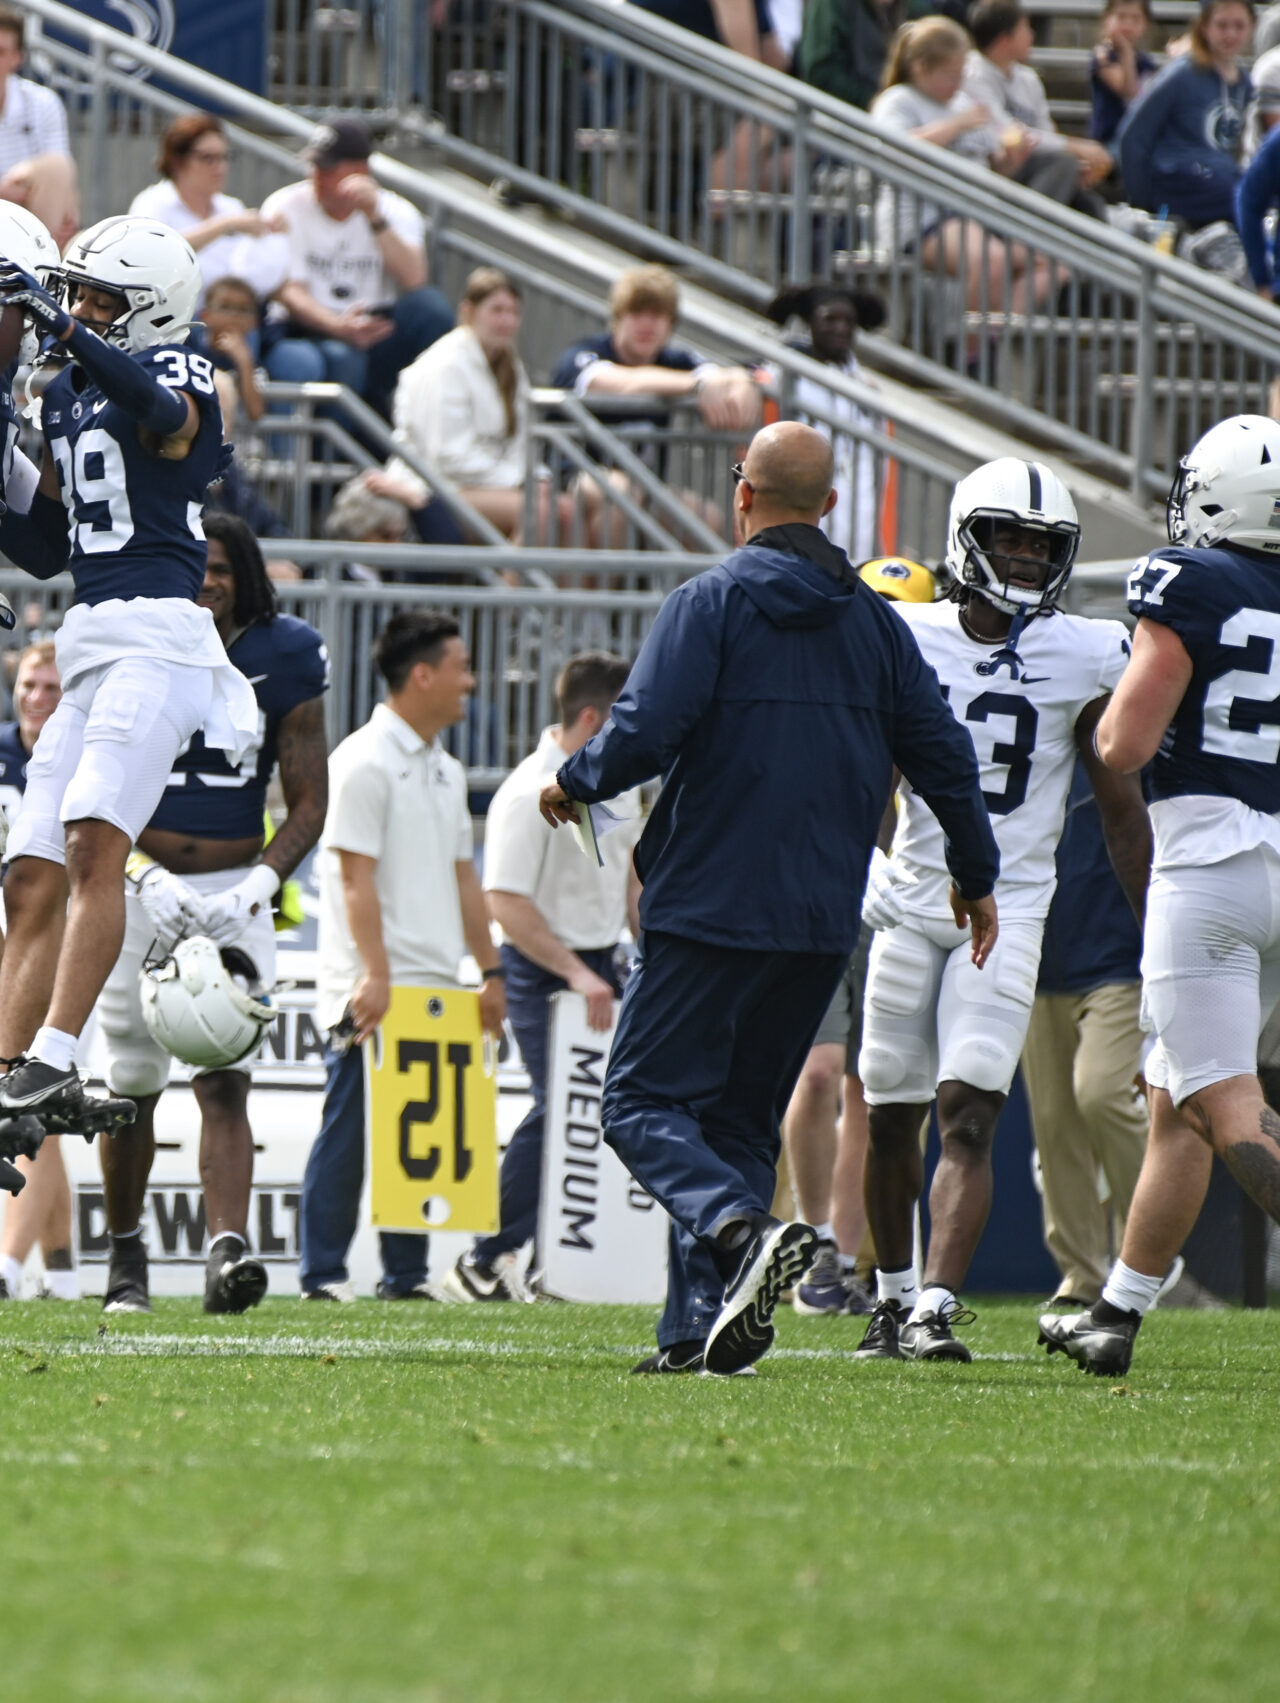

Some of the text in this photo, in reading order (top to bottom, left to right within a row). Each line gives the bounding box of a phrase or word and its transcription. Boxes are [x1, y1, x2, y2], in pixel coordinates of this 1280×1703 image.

[152, 351, 215, 395] 39
[1126, 556, 1182, 606] 27
[942, 684, 1038, 816] 3
[558, 1046, 605, 1253] MEDIUM
[78, 1193, 301, 1252] DWLT
